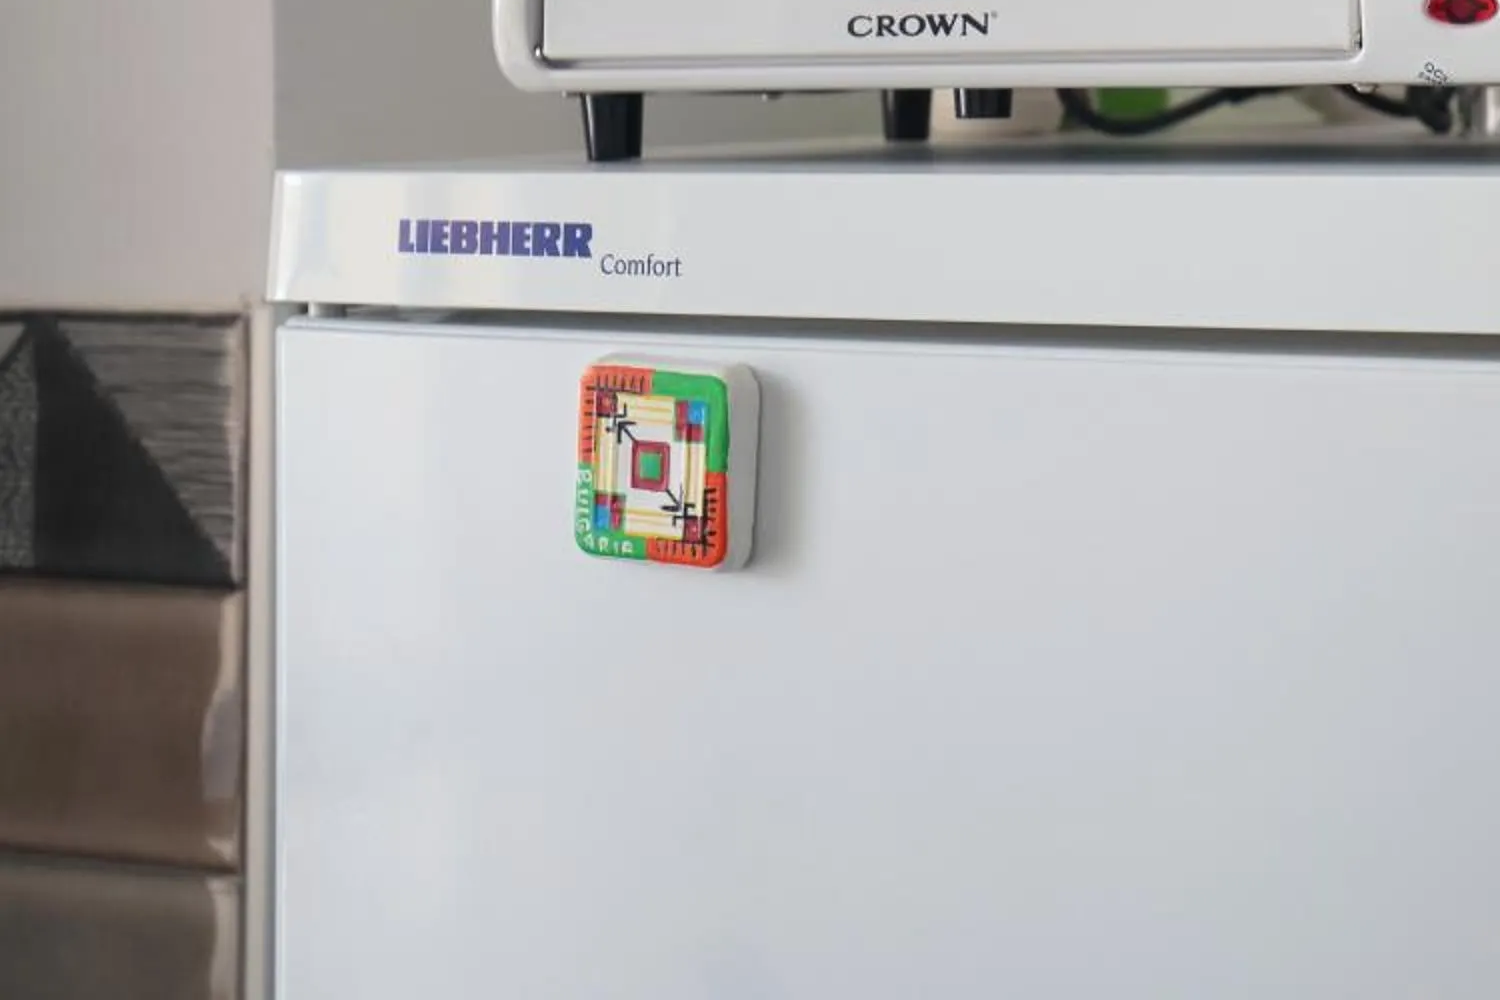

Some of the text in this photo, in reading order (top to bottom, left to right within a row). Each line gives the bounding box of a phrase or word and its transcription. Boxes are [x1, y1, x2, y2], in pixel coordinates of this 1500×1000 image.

[847, 12, 989, 37] CROWN
[398, 219, 593, 258] LIEBHERR
[600, 253, 682, 277] Comfort
